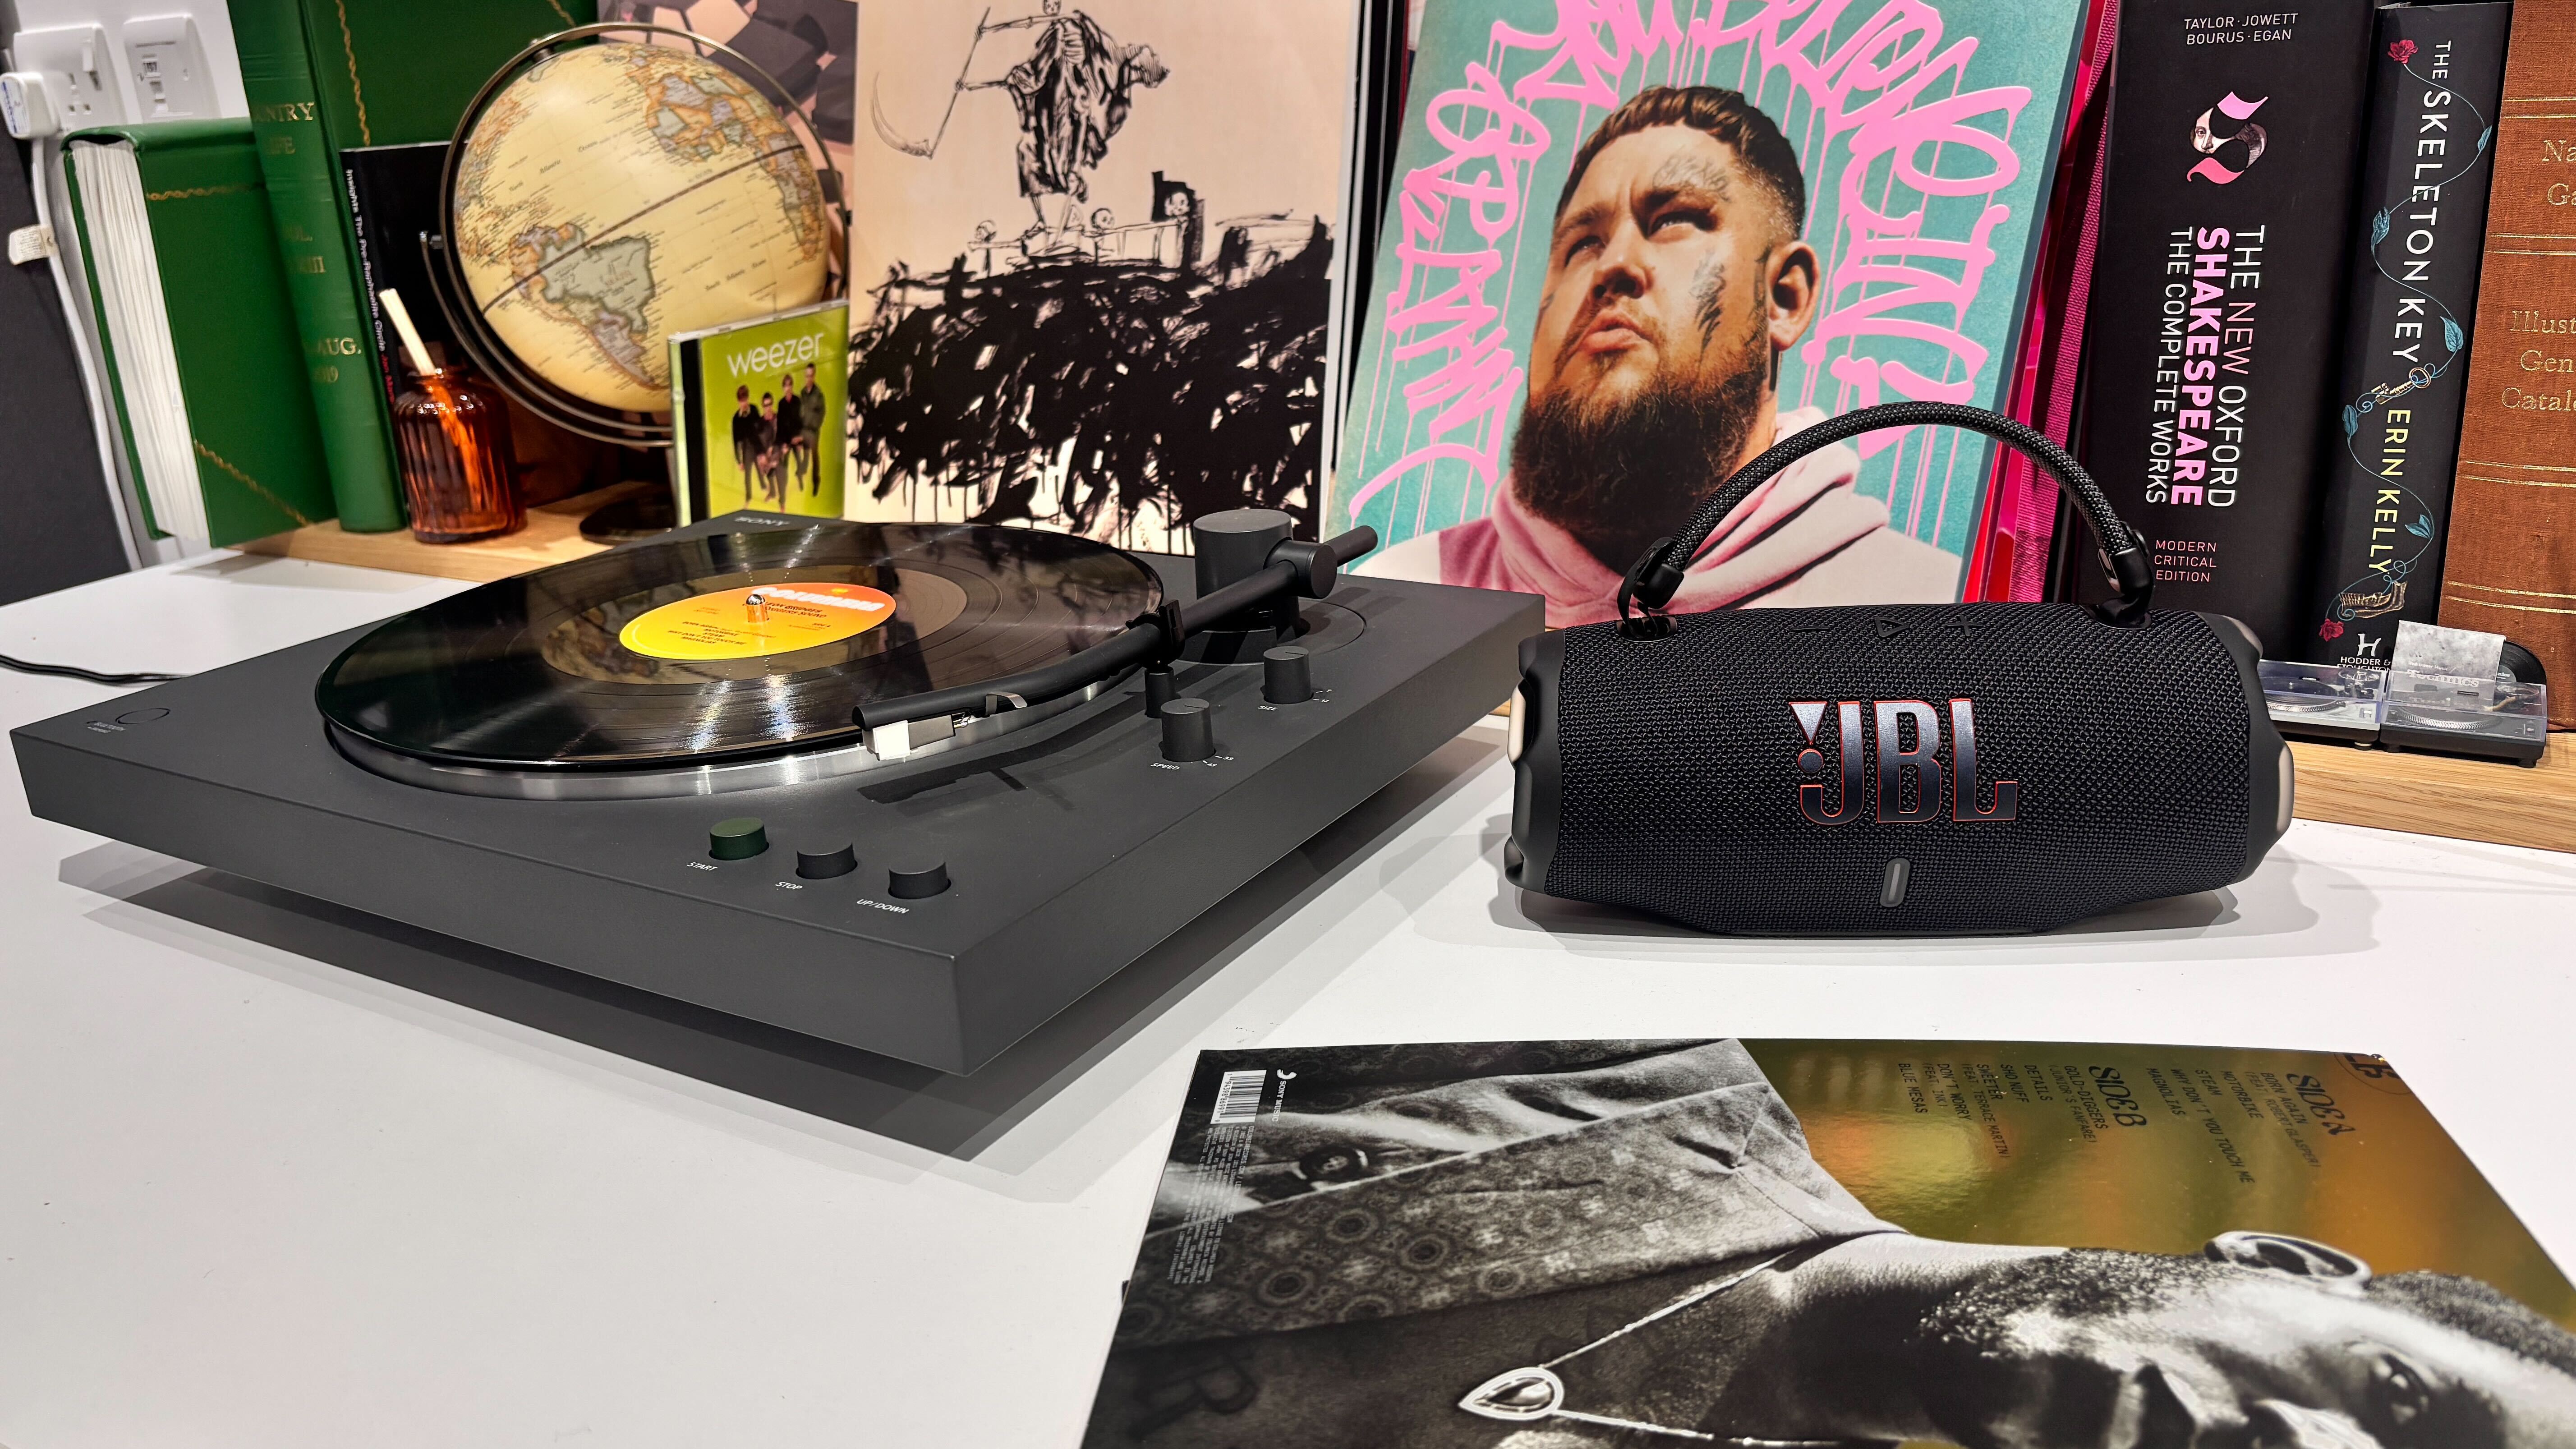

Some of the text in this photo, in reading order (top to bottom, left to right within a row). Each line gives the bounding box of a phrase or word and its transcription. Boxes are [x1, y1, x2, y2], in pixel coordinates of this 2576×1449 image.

[2184, 13, 2299, 30] TAYLOR JOWETT
[2186, 29, 2291, 45] BOURUS EGAN
[2392, 40, 2452, 363] THE SKELETON KEY
[727, 332, 824, 378] weezer
[2145, 226, 2193, 504] THE COMPLETE WORKS
[2170, 227, 2231, 506] SHAKESPEARE
[2207, 225, 2265, 507] THE NEW OXFORD
[2368, 409, 2411, 572] ERIN KELLY
[2153, 554, 2217, 568] CRITICAL
[2155, 540, 2217, 552] MODERN
[2155, 569, 2211, 583] EDITION
[2340, 656, 2381, 666] HODDER
[2357, 633, 2382, 657] H
[2407, 669, 2479, 687] Technics
[1150, 762, 1180, 770] SPEED
[1787, 698, 2018, 825] JBL
[687, 862, 718, 872] START
[775, 881, 803, 891] STOP
[857, 898, 910, 914] UP/DOWN
[1272, 1080, 1287, 1122] SONY MUSIC
[1898, 1063, 1928, 1114] BLUE MESAS
[1937, 1063, 1973, 1121] DON'T WORRY
[1976, 1063, 2004, 1100] SWEETER
[2001, 1063, 2029, 1104] SHO NUFF
[2024, 1064, 2053, 1101] DETAILS
[2064, 1065, 2109, 1129] GOLD-DIGGERS
[2088, 1065, 2148, 1128] SIDE B
[2145, 1067, 2186, 1116] MAGNOLIAS
[2195, 1069, 2223, 1096] STEAM
[2221, 1070, 2265, 1119] MOTORBIKE
[2171, 1069, 2256, 1184] WHY DON'T YOU TOUCH ME
